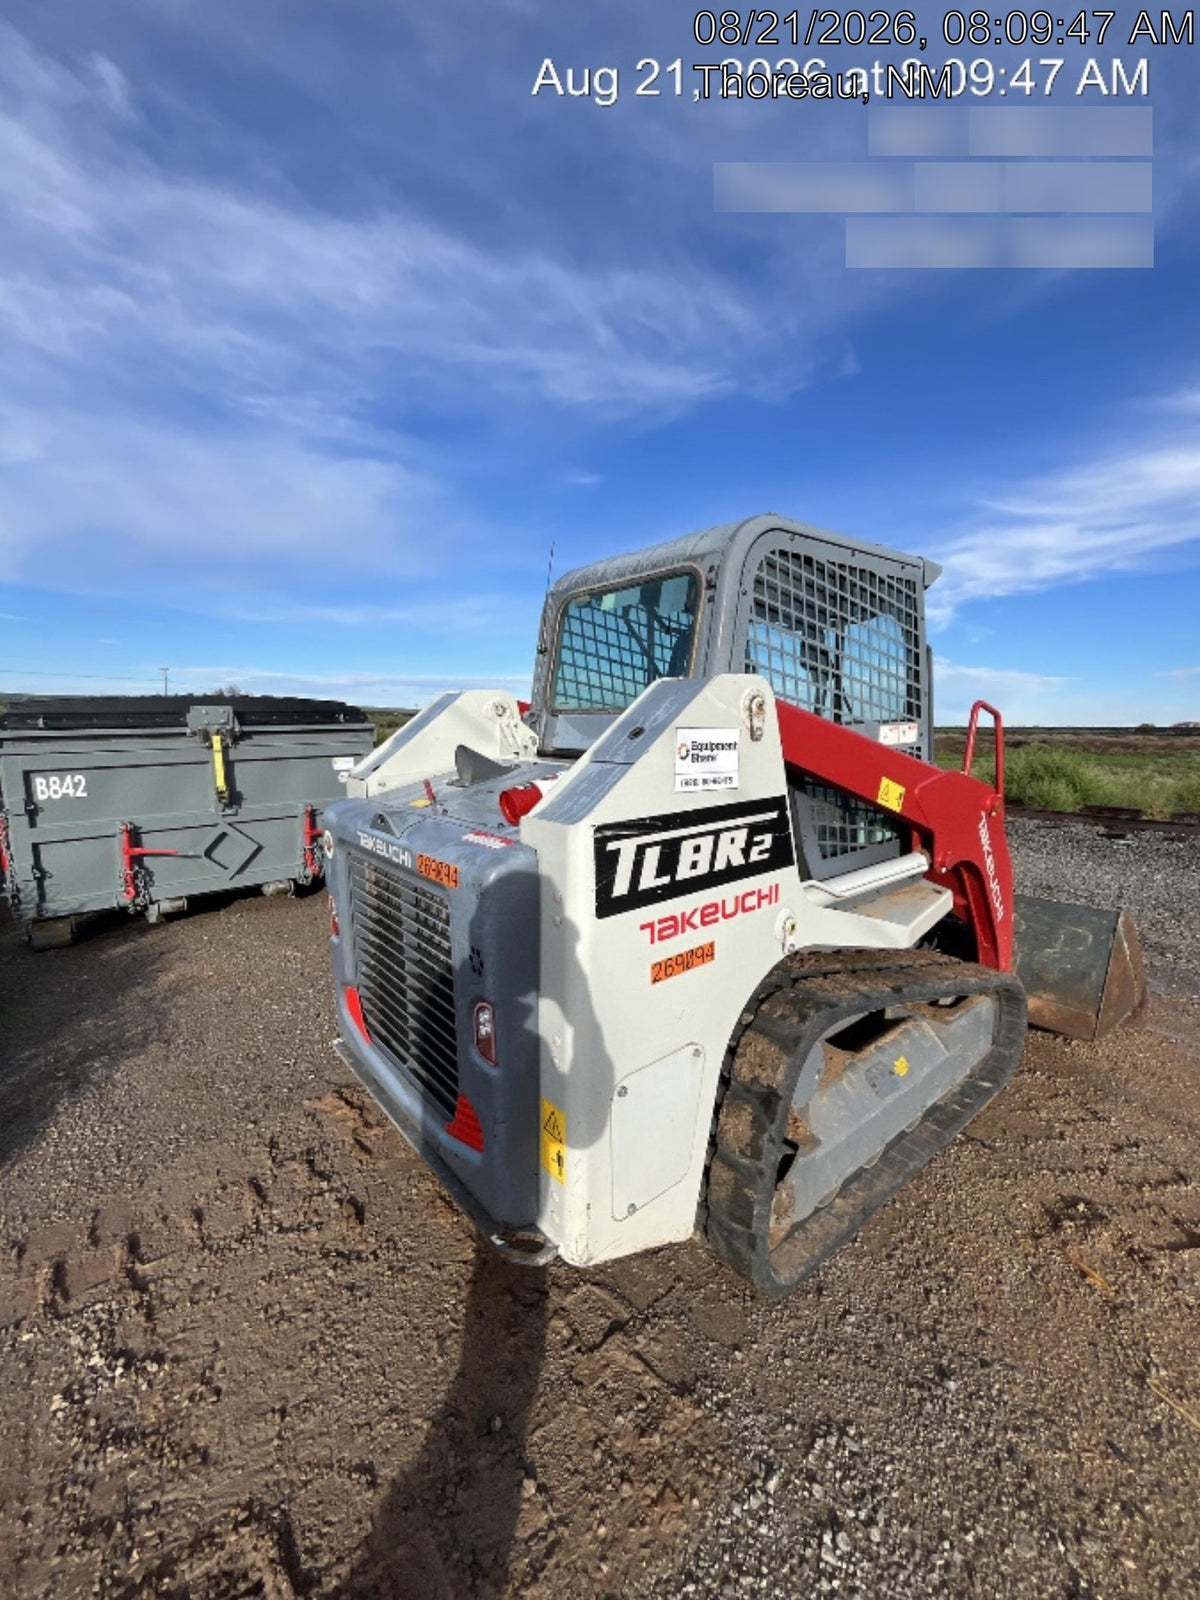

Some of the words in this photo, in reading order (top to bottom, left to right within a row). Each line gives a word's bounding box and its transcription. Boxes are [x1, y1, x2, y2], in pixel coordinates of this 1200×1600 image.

[691, 741, 738, 752] Equipment
[35, 774, 88, 801] B842
[639, 883, 780, 945] TAKEUCHI
[651, 941, 715, 984] 269094
